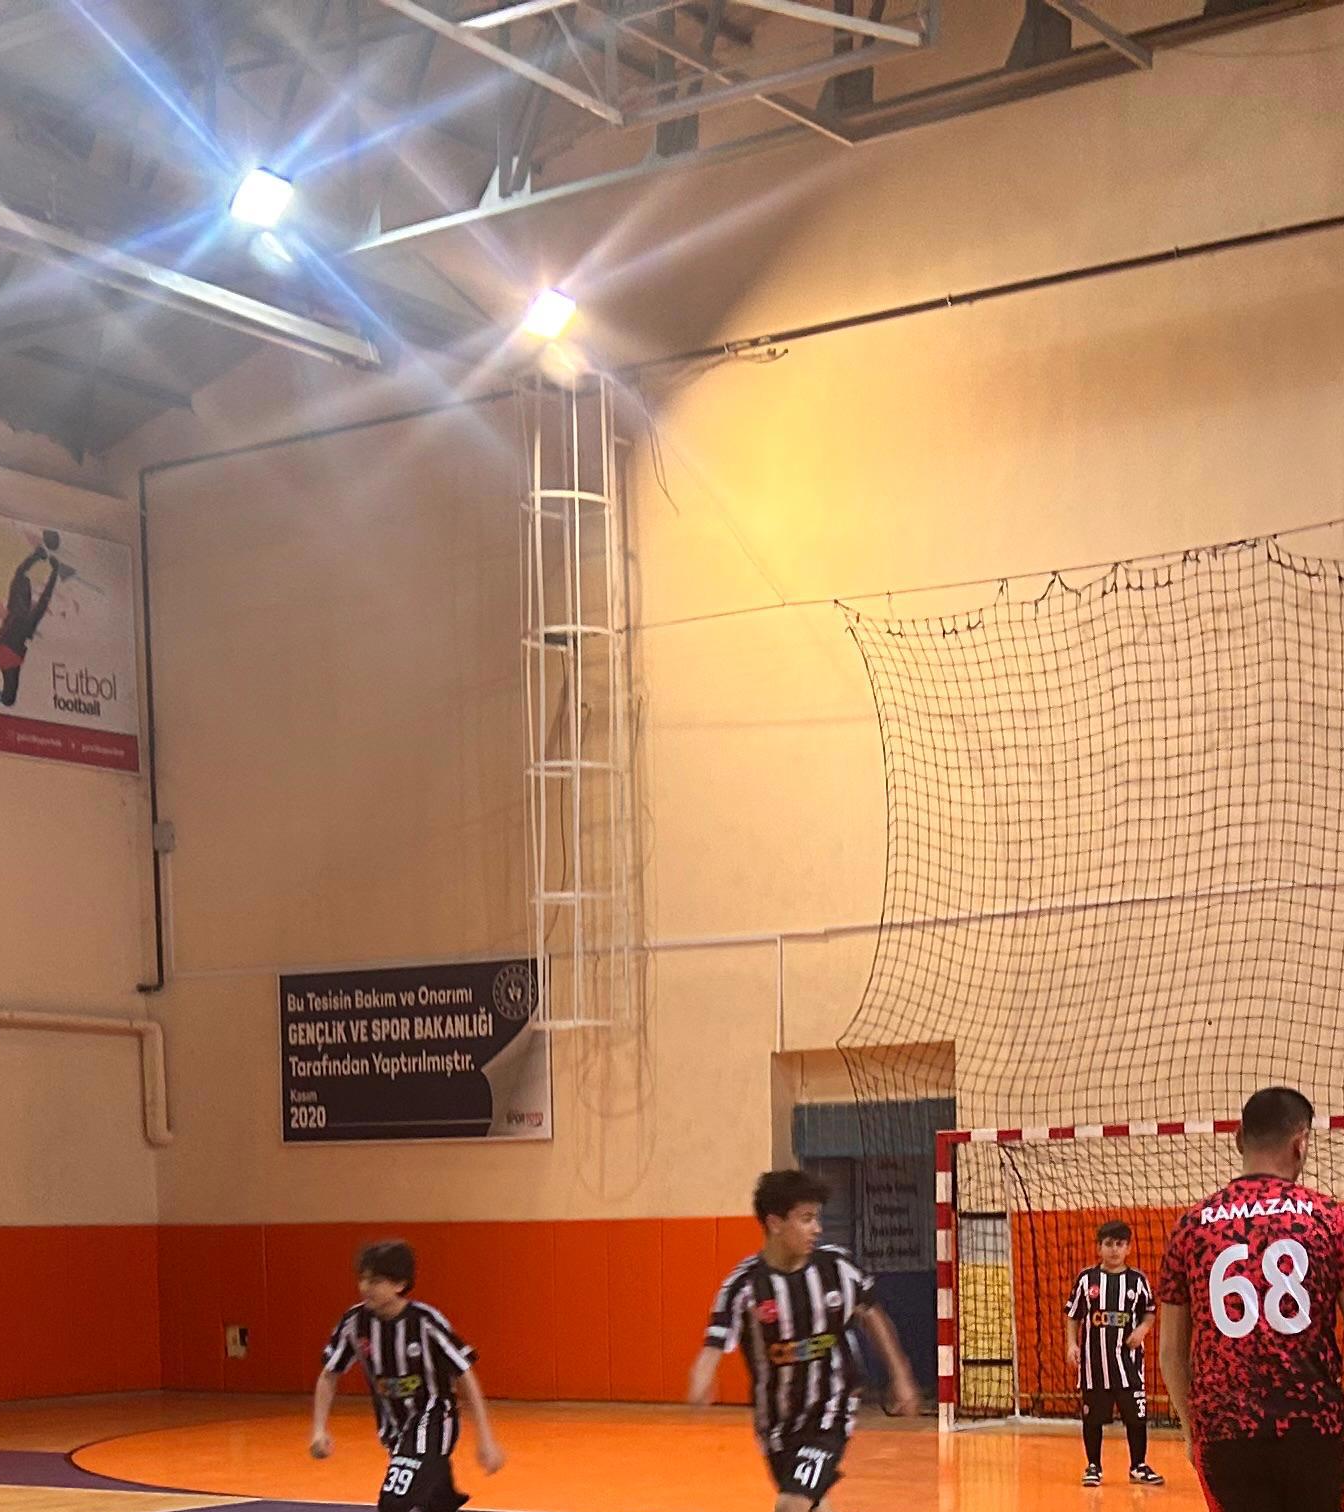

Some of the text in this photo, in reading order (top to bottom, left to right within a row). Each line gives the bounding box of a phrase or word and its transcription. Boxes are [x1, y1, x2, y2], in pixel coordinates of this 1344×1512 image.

[52, 662, 117, 701] Futbol
[53, 694, 101, 717] football
[287, 986, 473, 1012] Bu Tesisin Bakım ve Onarımı
[288, 1006, 494, 1052] GENÇLİK VE SPOR BAKANLIĞI
[289, 1050, 475, 1080] Tarafından Yaptırılmıştır.
[290, 1105, 327, 1129] 2020
[1200, 1198, 1313, 1225] RAMAZAN
[1209, 1238, 1312, 1339] 68
[383, 1466, 414, 1496] 39
[793, 1453, 827, 1489] 41
